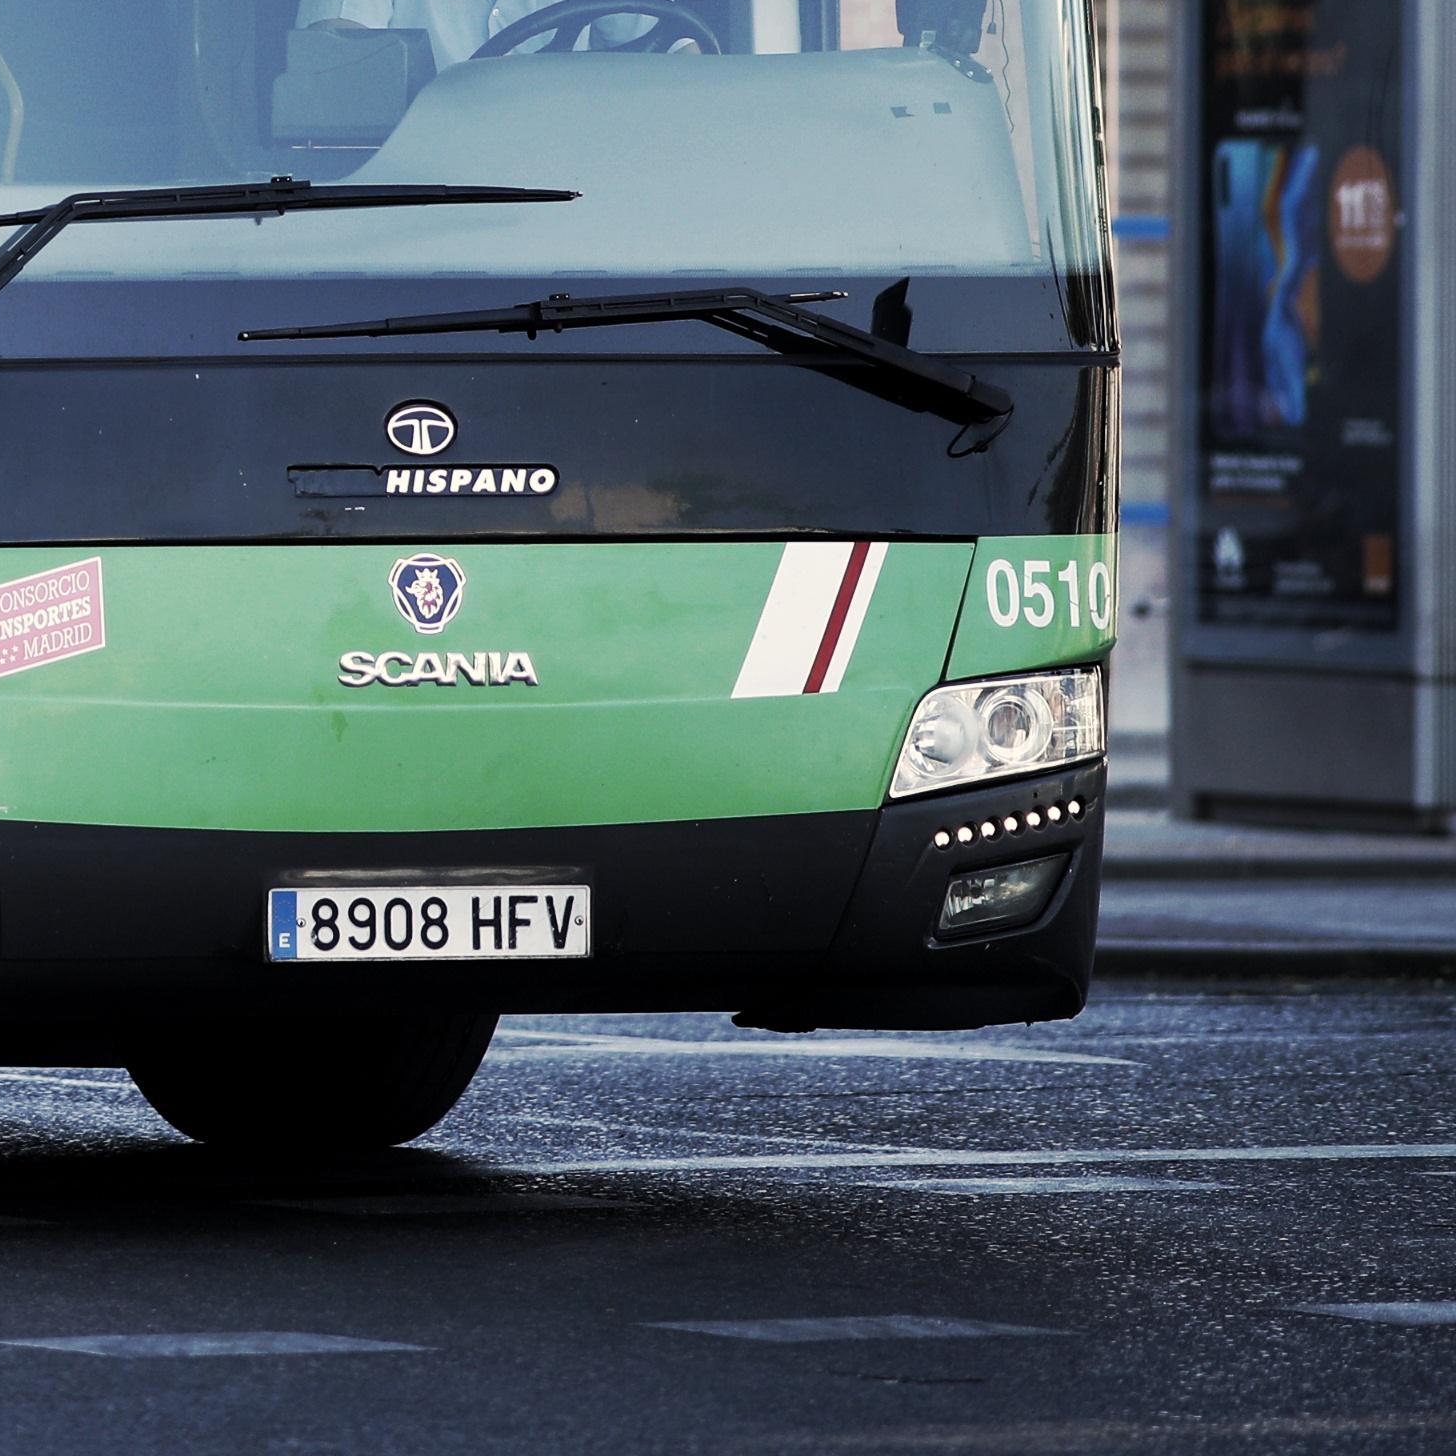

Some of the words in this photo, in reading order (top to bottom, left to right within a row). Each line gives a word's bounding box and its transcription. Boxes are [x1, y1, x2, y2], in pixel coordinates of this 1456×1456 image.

[385, 468, 556, 494] HISPANO
[986, 558, 1111, 630] 0510
[23, 622, 93, 661] MADRID
[338, 650, 539, 687] SCANIA
[278, 932, 291, 949] E
[310, 896, 450, 951] 8908
[471, 895, 575, 950] HFV
